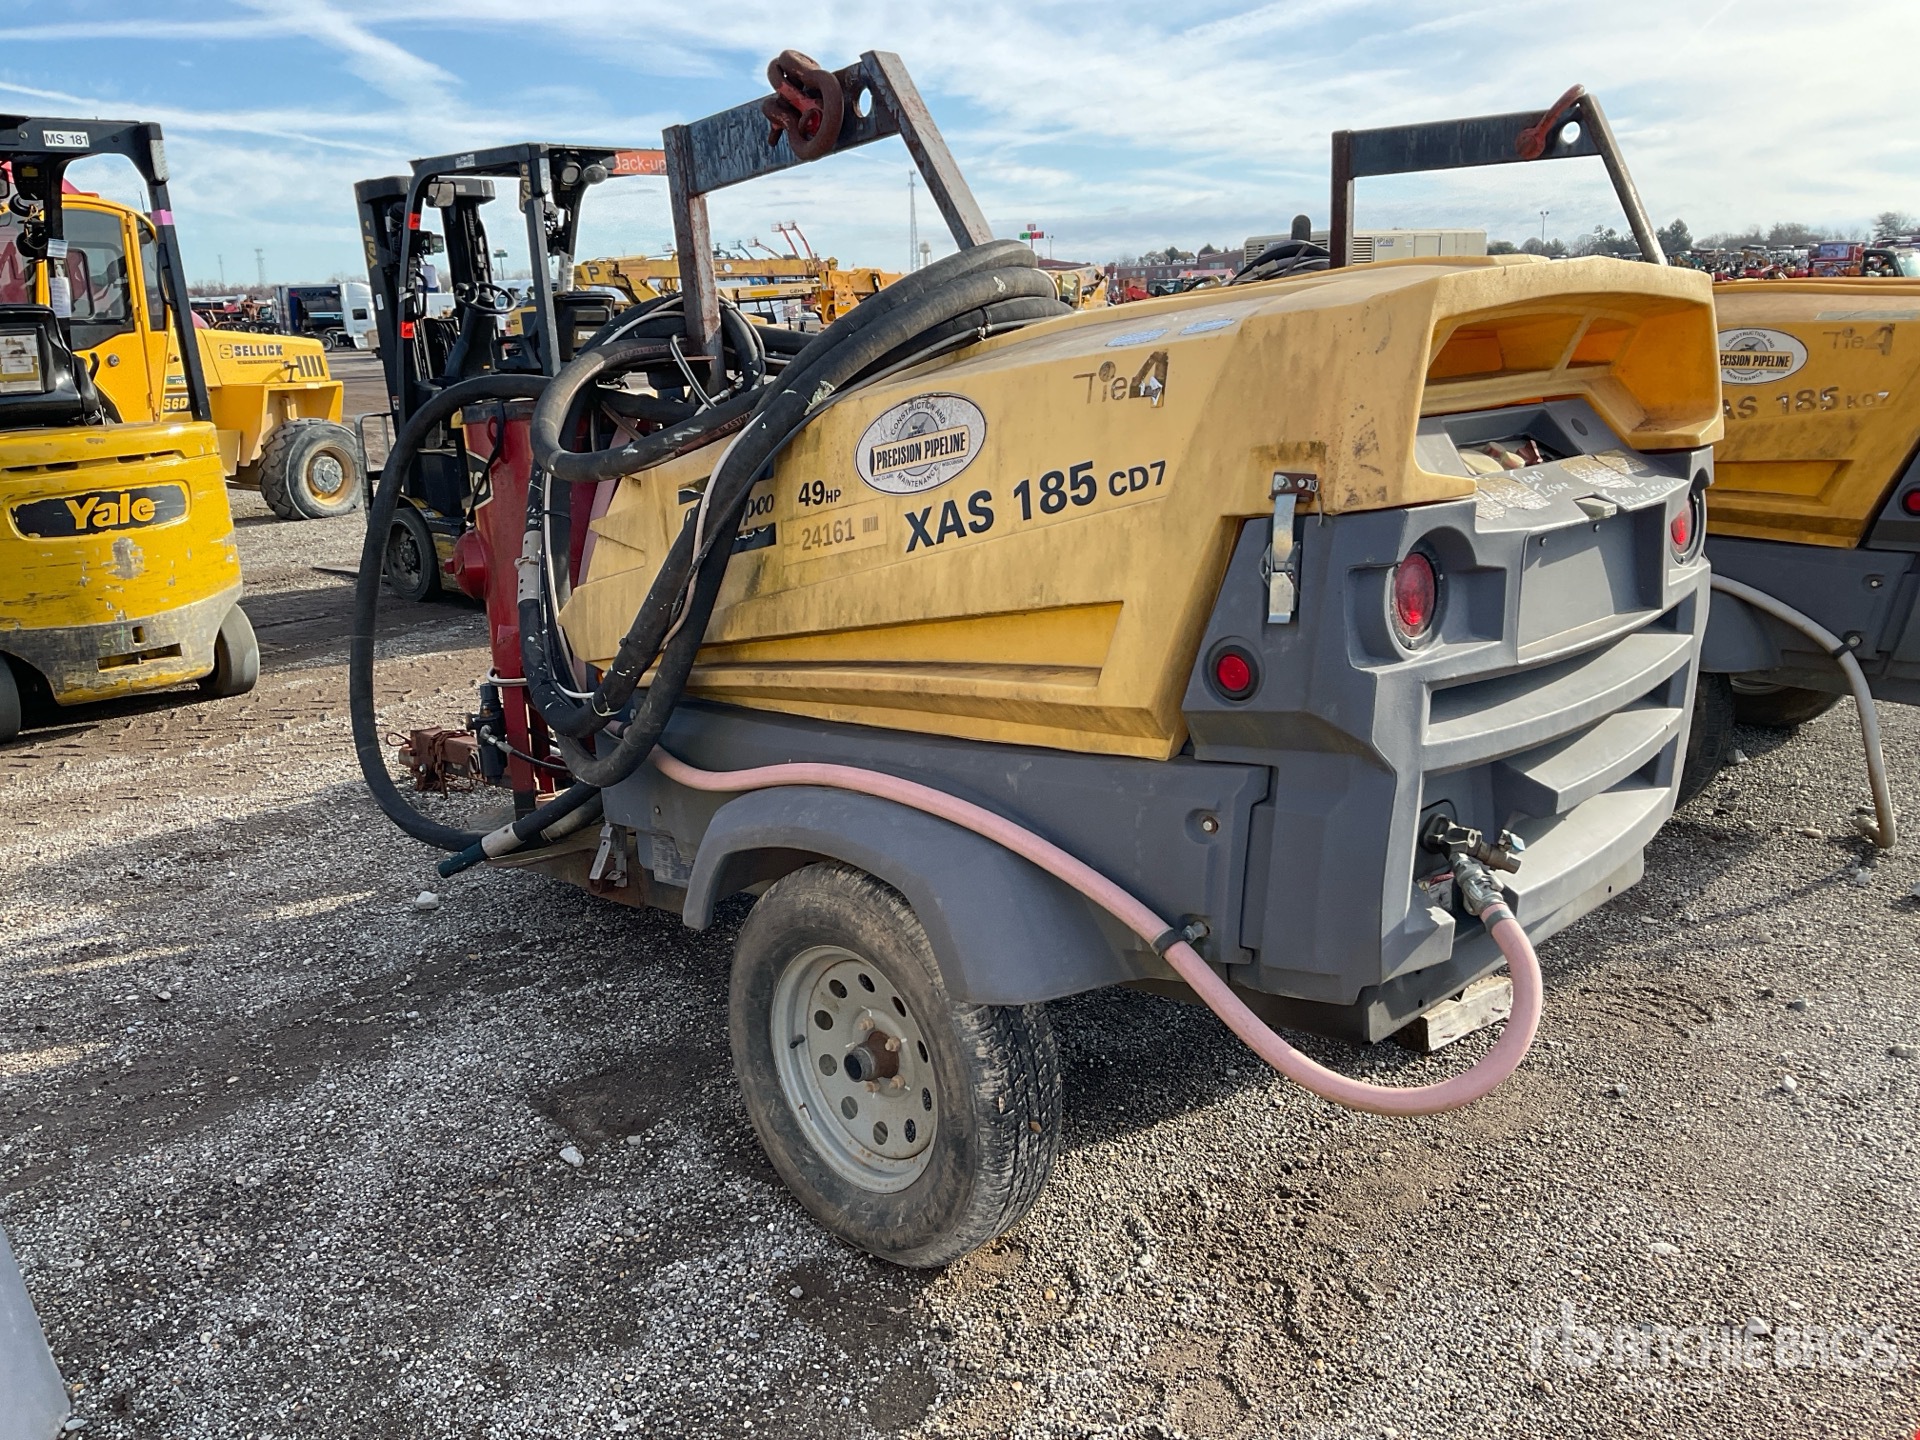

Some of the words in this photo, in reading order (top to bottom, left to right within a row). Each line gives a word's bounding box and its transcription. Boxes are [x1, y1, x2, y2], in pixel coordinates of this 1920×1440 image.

[45, 133, 65, 145] MS
[69, 134, 88, 146] 181
[234, 344, 283, 357] SELLICK
[1725, 331, 1767, 348] CONSTRUCTION
[1720, 354, 1751, 367] ECISION
[1752, 355, 1790, 368] PIPELINE
[890, 401, 936, 436] CONSTRUCTION
[934, 405, 946, 425] AND
[1721, 395, 1759, 420] AS
[1775, 387, 1840, 415] 185
[876, 441, 922, 471] PRECISION
[924, 432, 966, 460] PIPELINE
[896, 465, 940, 488] MAINTENANCE
[65, 492, 156, 530] Yale
[904, 489, 995, 554] XAS
[1013, 461, 1098, 521] 185
[1108, 460, 1167, 497] CD7
[801, 517, 856, 551] 24161
